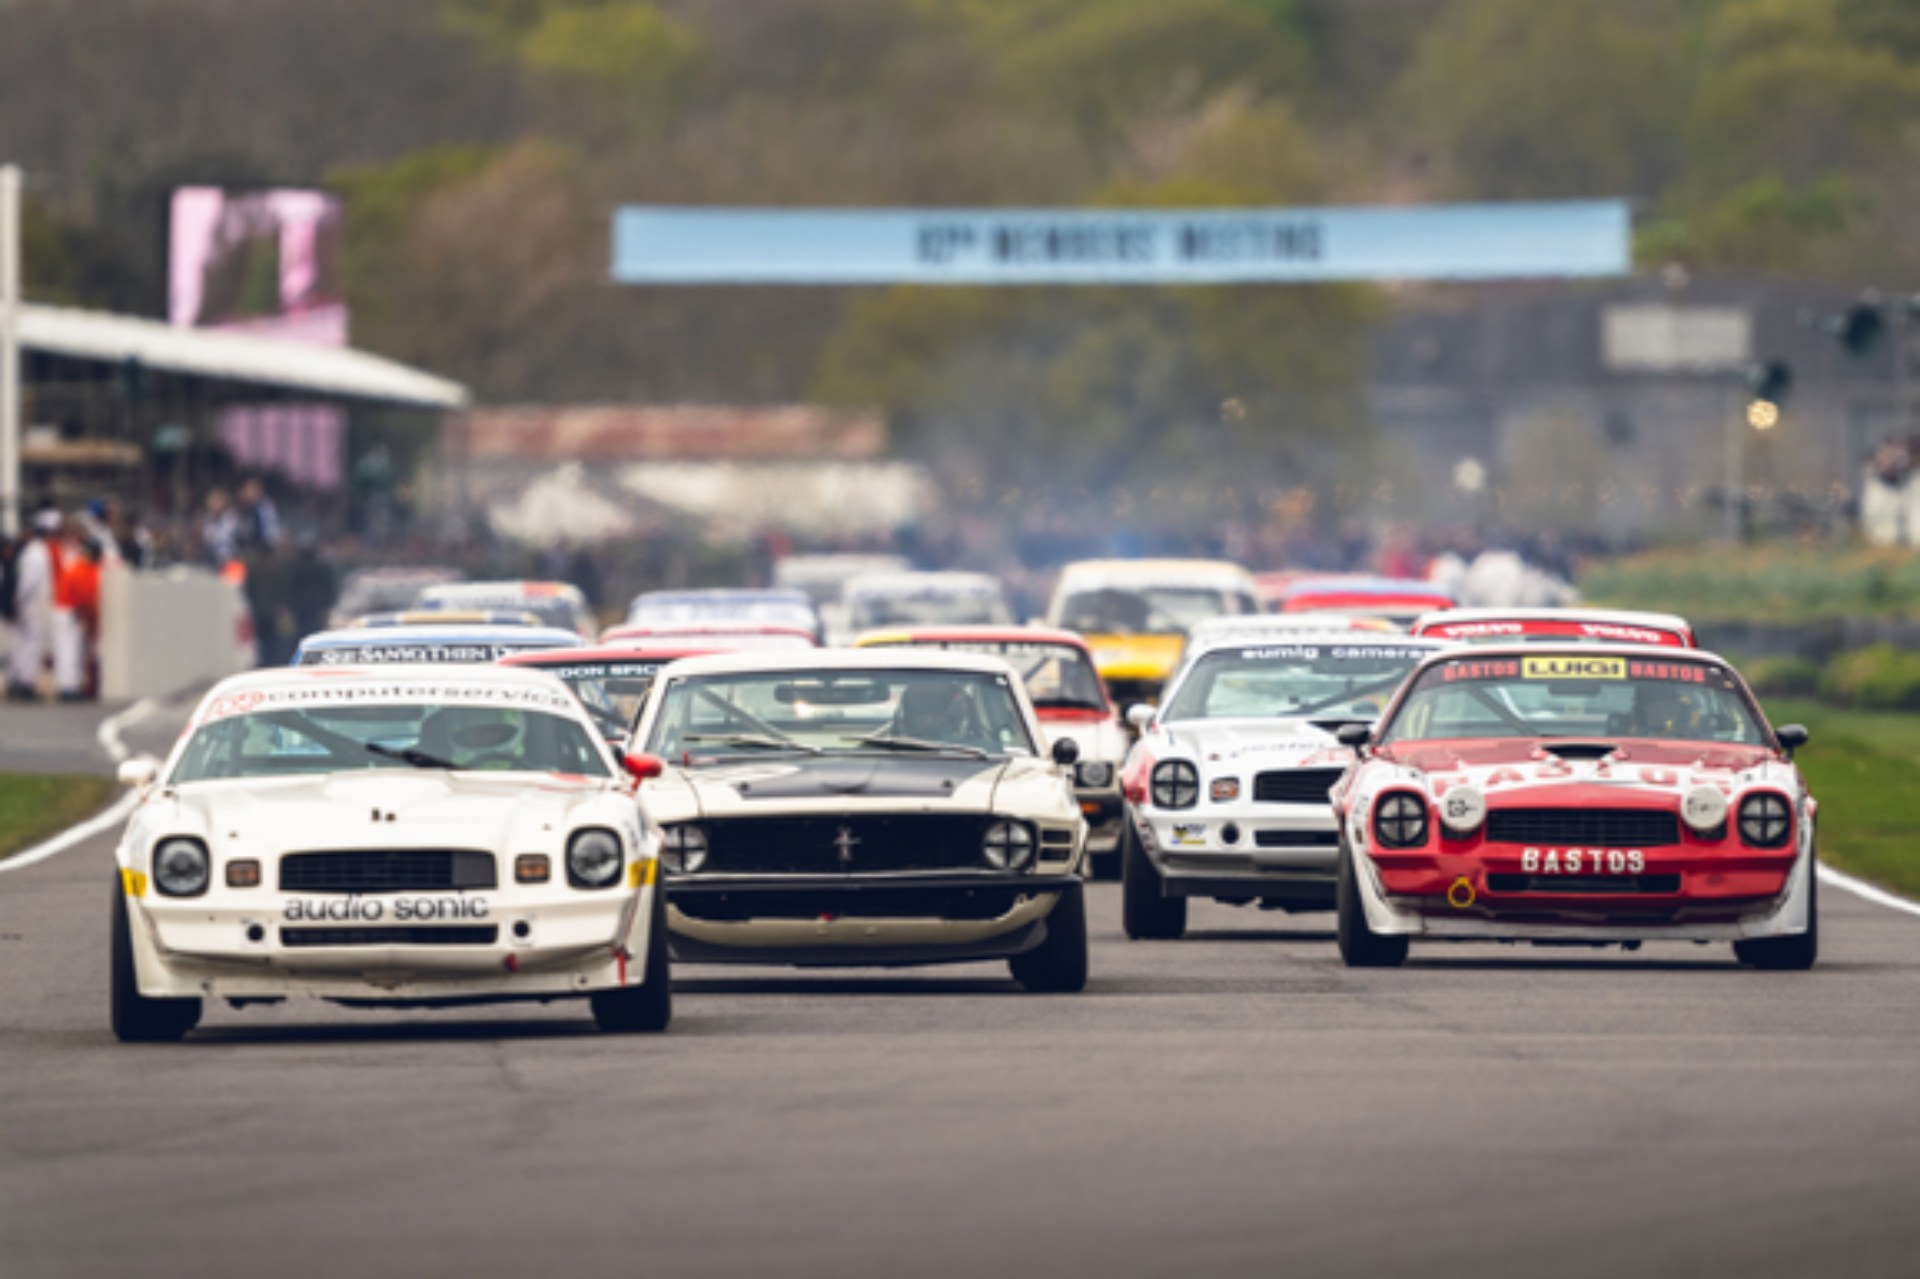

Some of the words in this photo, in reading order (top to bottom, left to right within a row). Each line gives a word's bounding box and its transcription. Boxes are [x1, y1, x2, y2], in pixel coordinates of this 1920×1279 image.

[1581, 624, 1661, 641] VOLVO
[1241, 645, 1319, 660] eumig
[1444, 663, 1518, 681] BASTOS
[1529, 661, 1618, 676] LUIGI
[1630, 663, 1705, 682] BASTOS
[1521, 847, 1647, 874] BASTOS
[284, 892, 383, 920] audio
[394, 890, 489, 920] sonic
